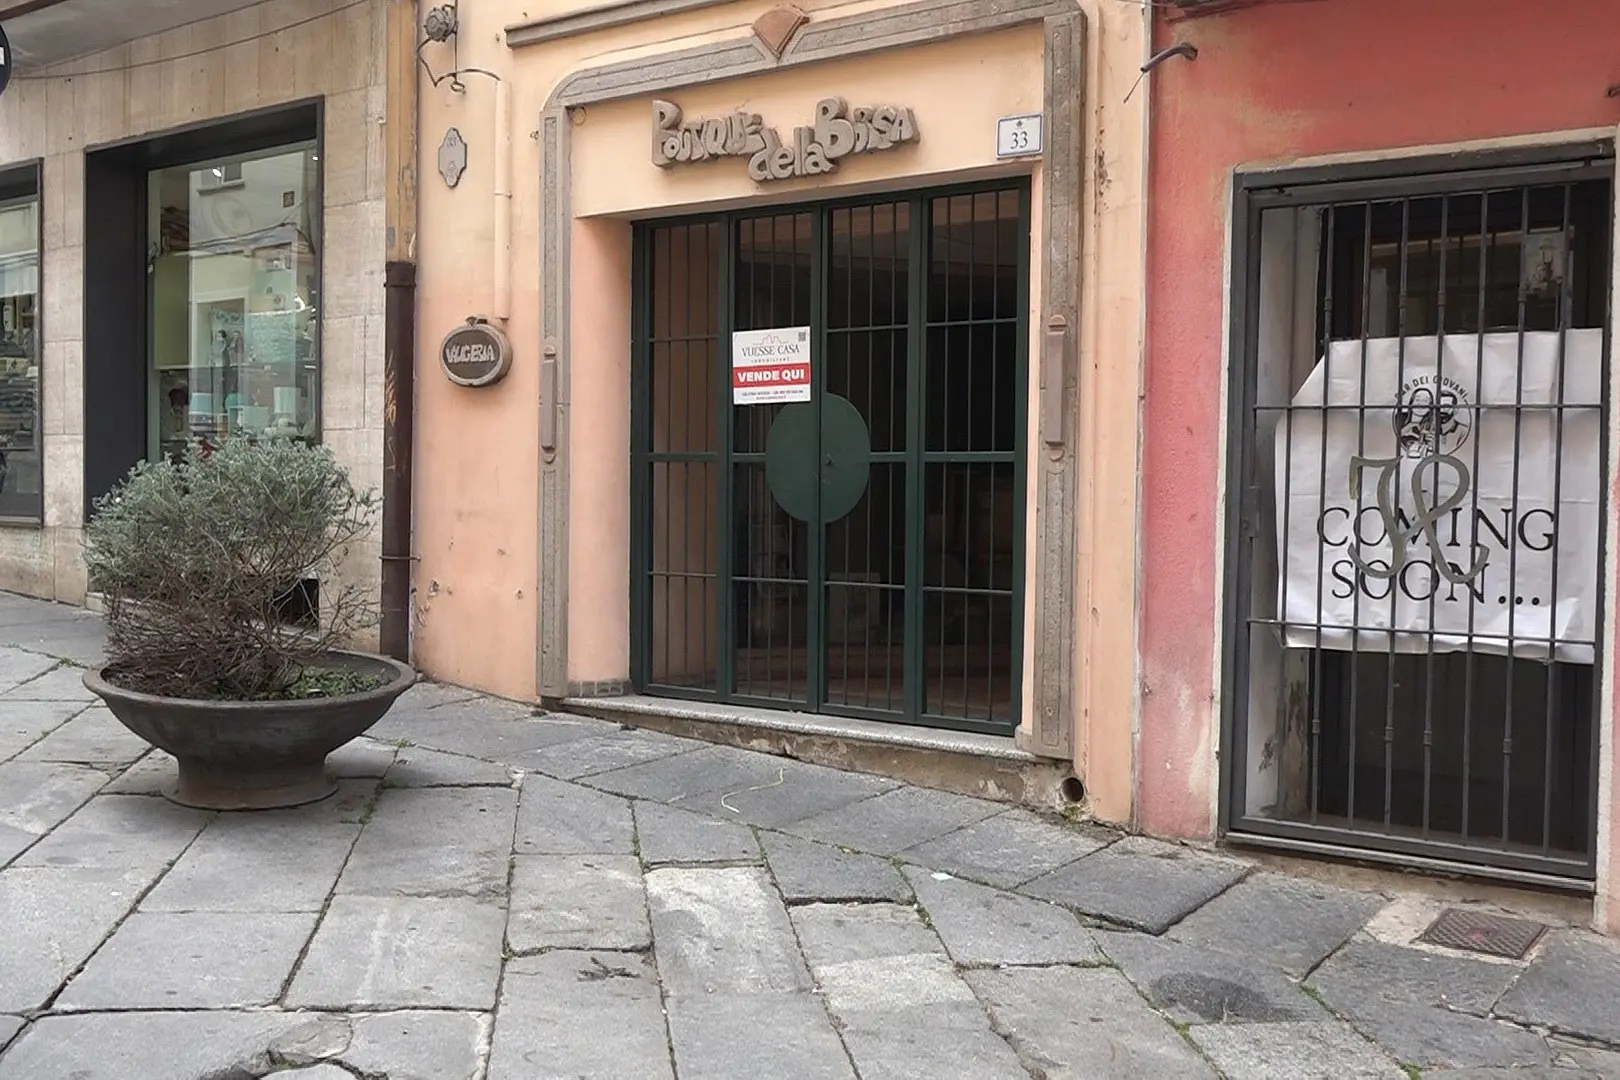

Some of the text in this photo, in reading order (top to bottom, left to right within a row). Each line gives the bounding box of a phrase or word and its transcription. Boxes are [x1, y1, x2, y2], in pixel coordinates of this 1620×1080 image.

[1010, 131, 1028, 150] 33
[748, 127, 834, 182] della
[741, 343, 800, 357] VUESSE CASA
[737, 368, 805, 383] VENDE QUI
[1412, 375, 1429, 388] DEI
[1432, 375, 1469, 399] GOVANI
